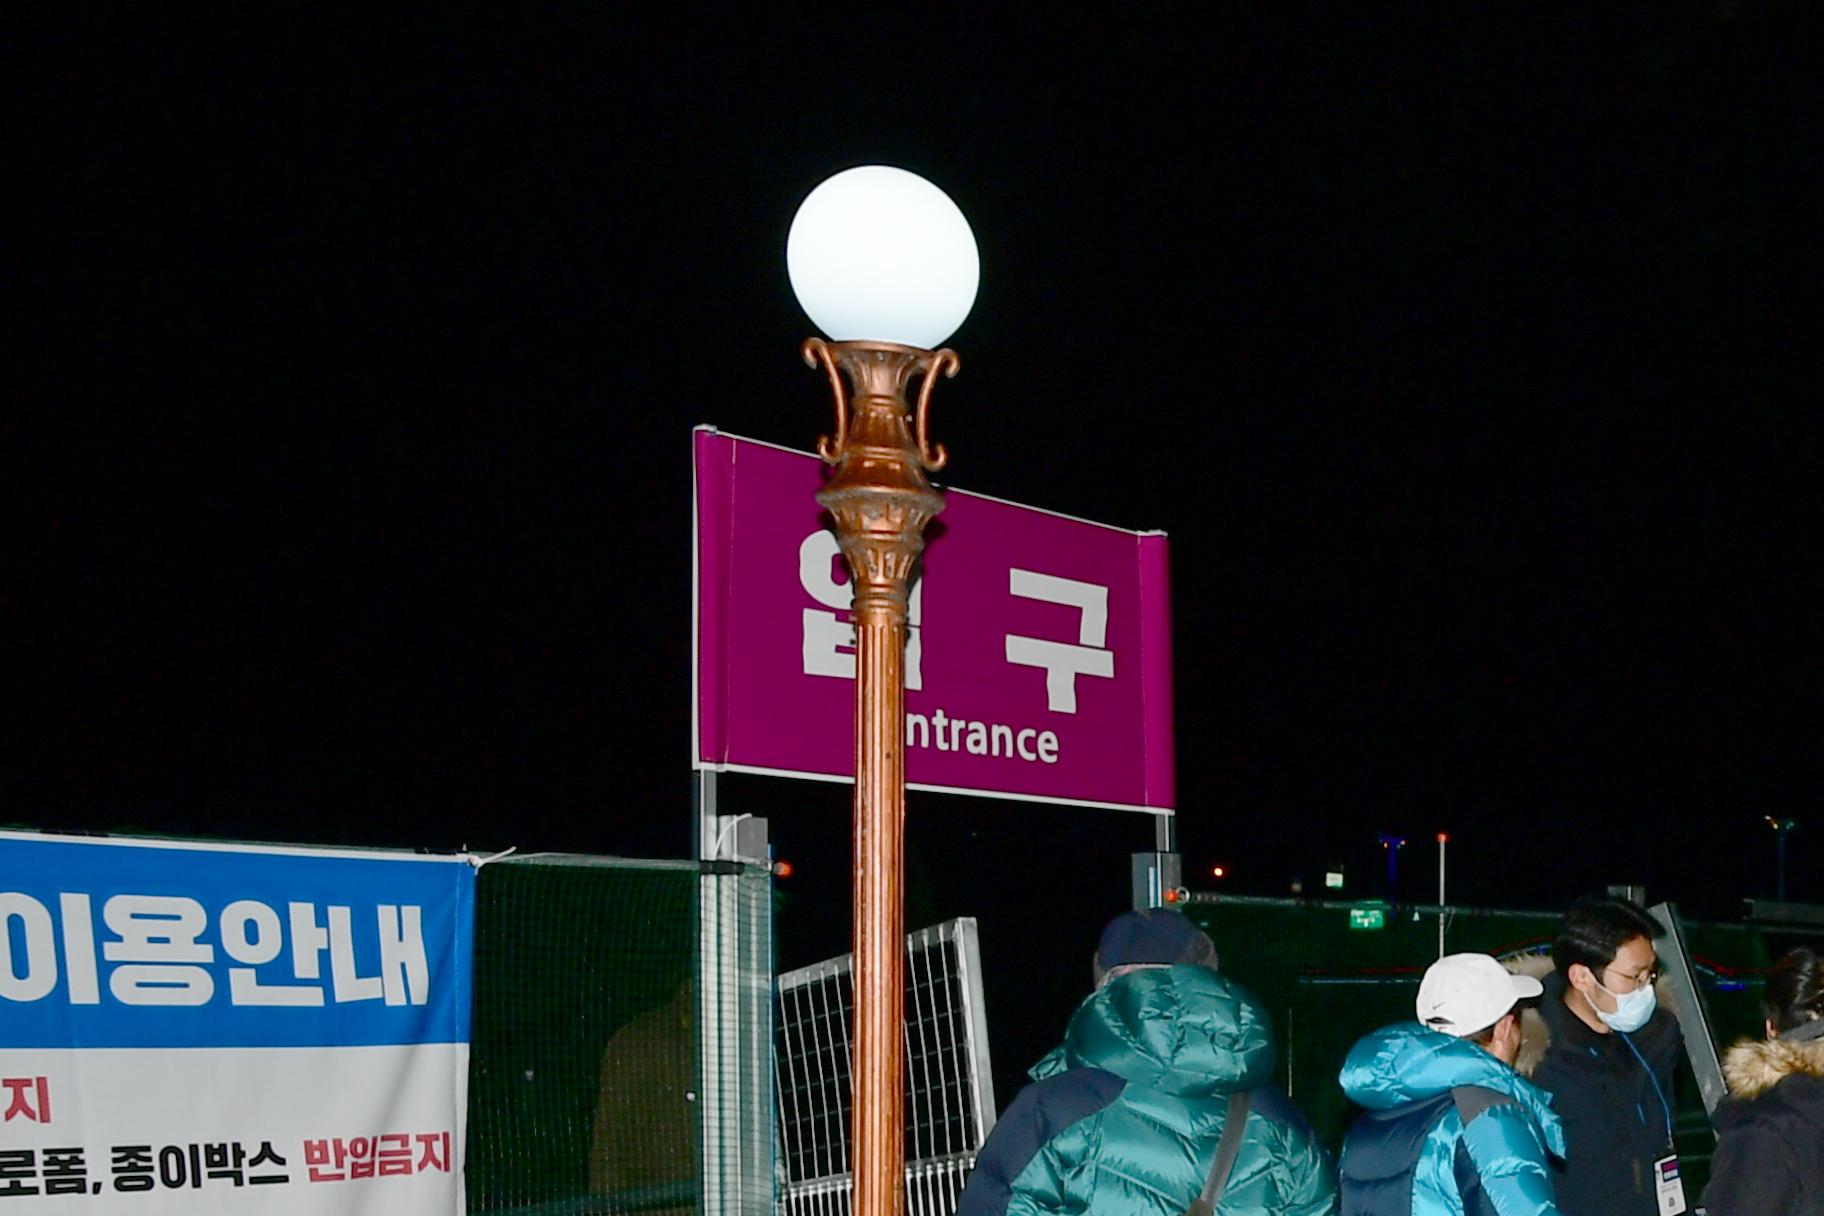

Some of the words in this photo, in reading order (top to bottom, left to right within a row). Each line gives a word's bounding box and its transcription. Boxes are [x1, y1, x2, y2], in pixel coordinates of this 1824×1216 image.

[905, 708, 1060, 764] ntrance
[0, 892, 430, 1006] 이용안내
[303, 1131, 452, 1183] 반입금지
